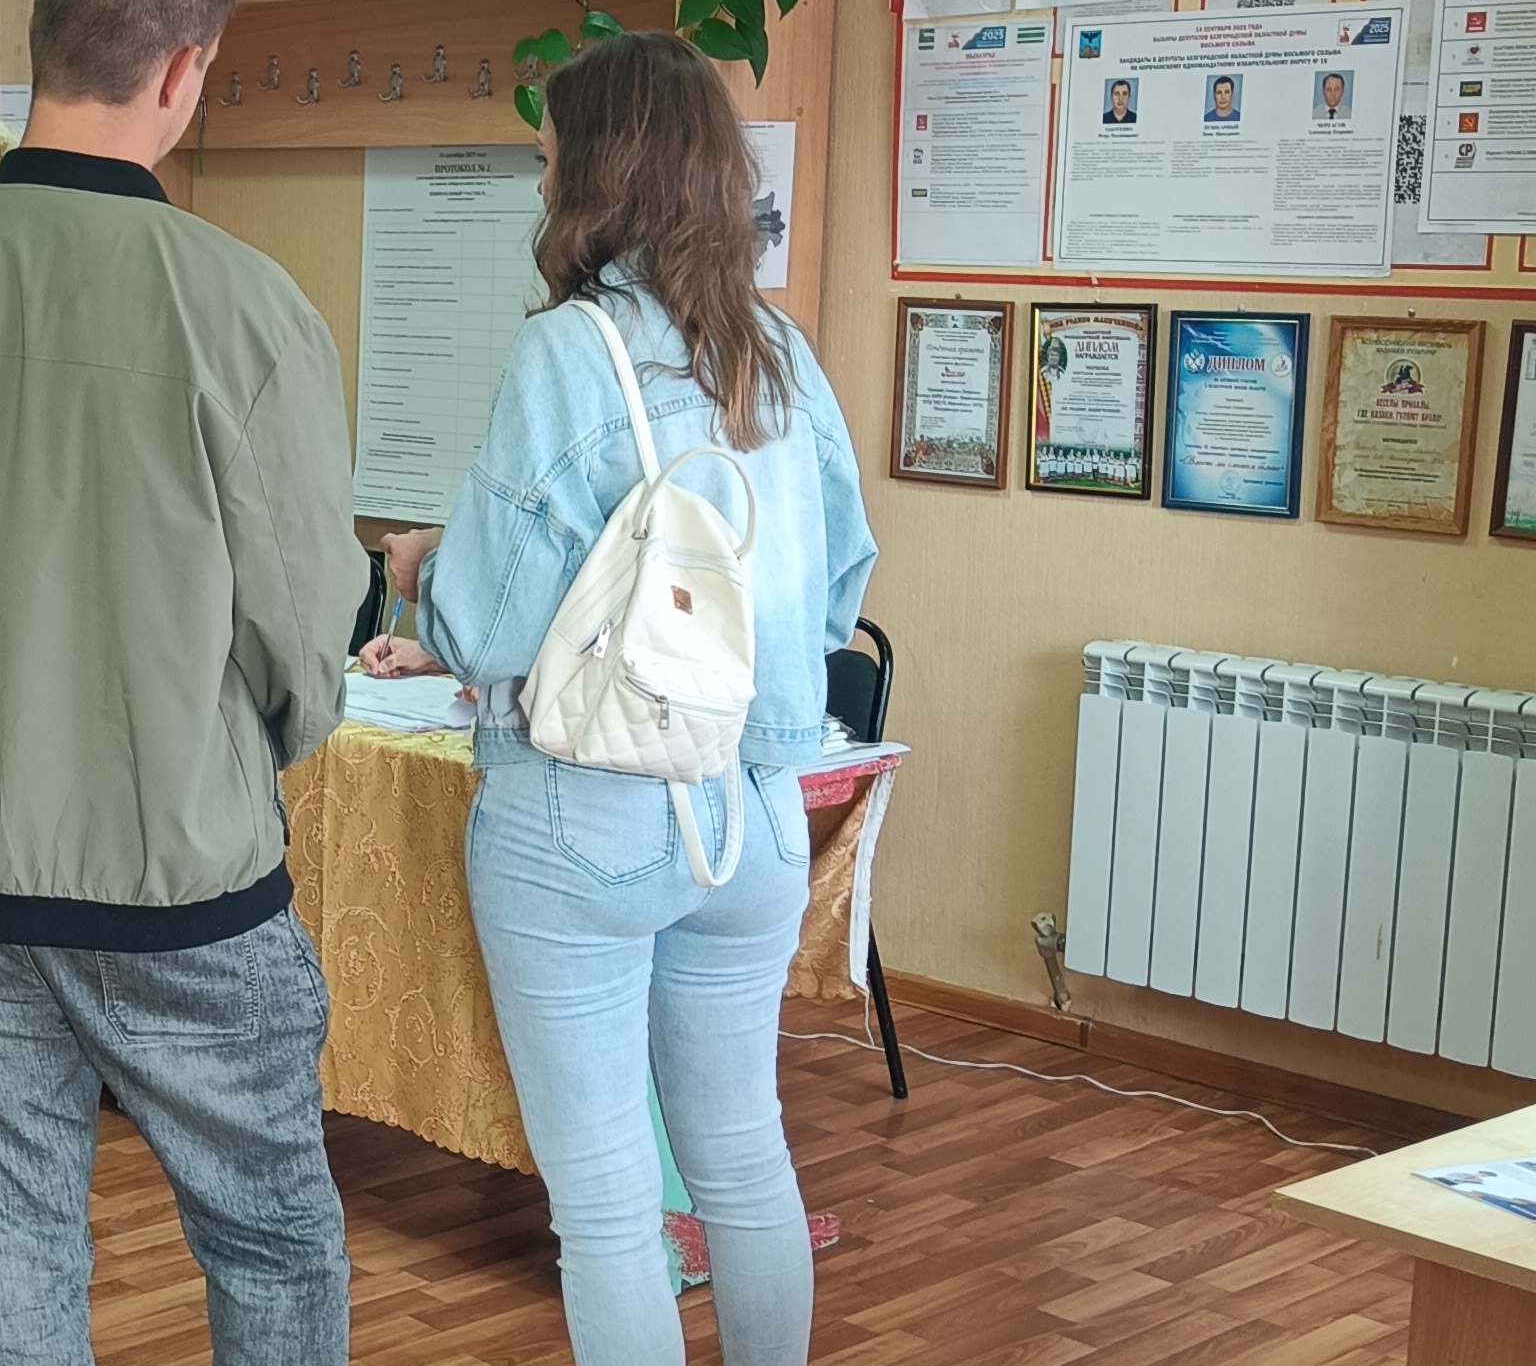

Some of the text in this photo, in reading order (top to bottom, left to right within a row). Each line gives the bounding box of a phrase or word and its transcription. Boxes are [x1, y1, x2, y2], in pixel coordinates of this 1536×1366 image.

[1369, 24, 1390, 33] 2025
[1459, 143, 1473, 156] СР
[435, 164, 476, 173] ПРОТОКОЛ
[1075, 341, 1120, 353] ДИПЛОМ
[1207, 355, 1266, 373] ДИПЛОМ
